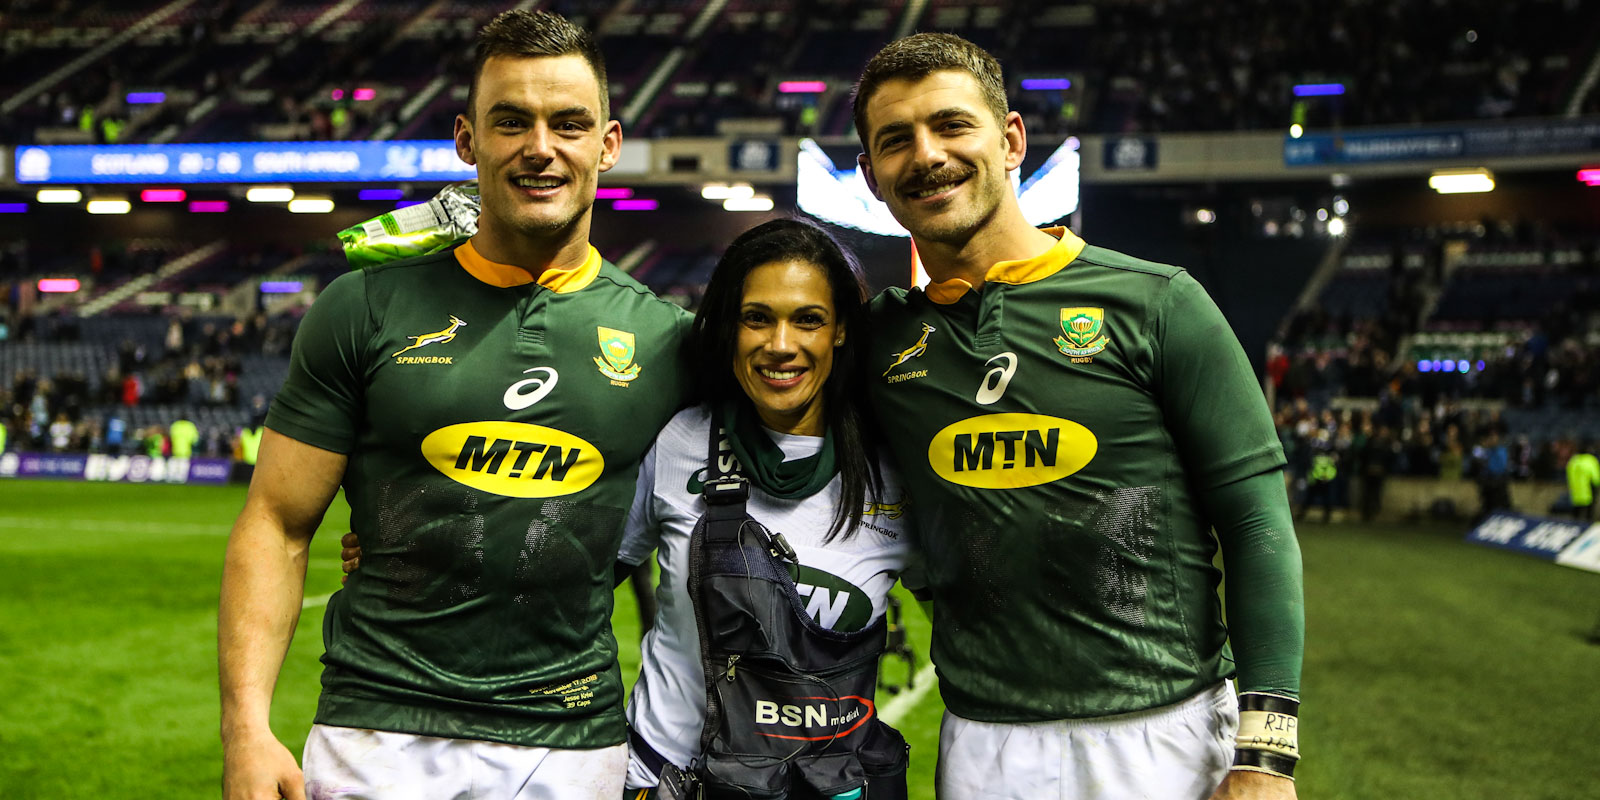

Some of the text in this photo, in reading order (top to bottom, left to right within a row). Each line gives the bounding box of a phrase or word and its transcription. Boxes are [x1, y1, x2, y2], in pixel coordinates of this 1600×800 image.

[395, 356, 453, 365] SPRINGBOK
[1070, 356, 1094, 364] RUGBY
[887, 369, 929, 384] SPRINGBOK
[454, 435, 581, 482] MTN
[954, 427, 1060, 473] MTN
[857, 519, 899, 540] PRINGBOK
[562, 694, 580, 703] Jesse
[566, 699, 591, 709] 39 Caps
[755, 700, 860, 728] BSN medical
[1264, 712, 1296, 733] RIP
